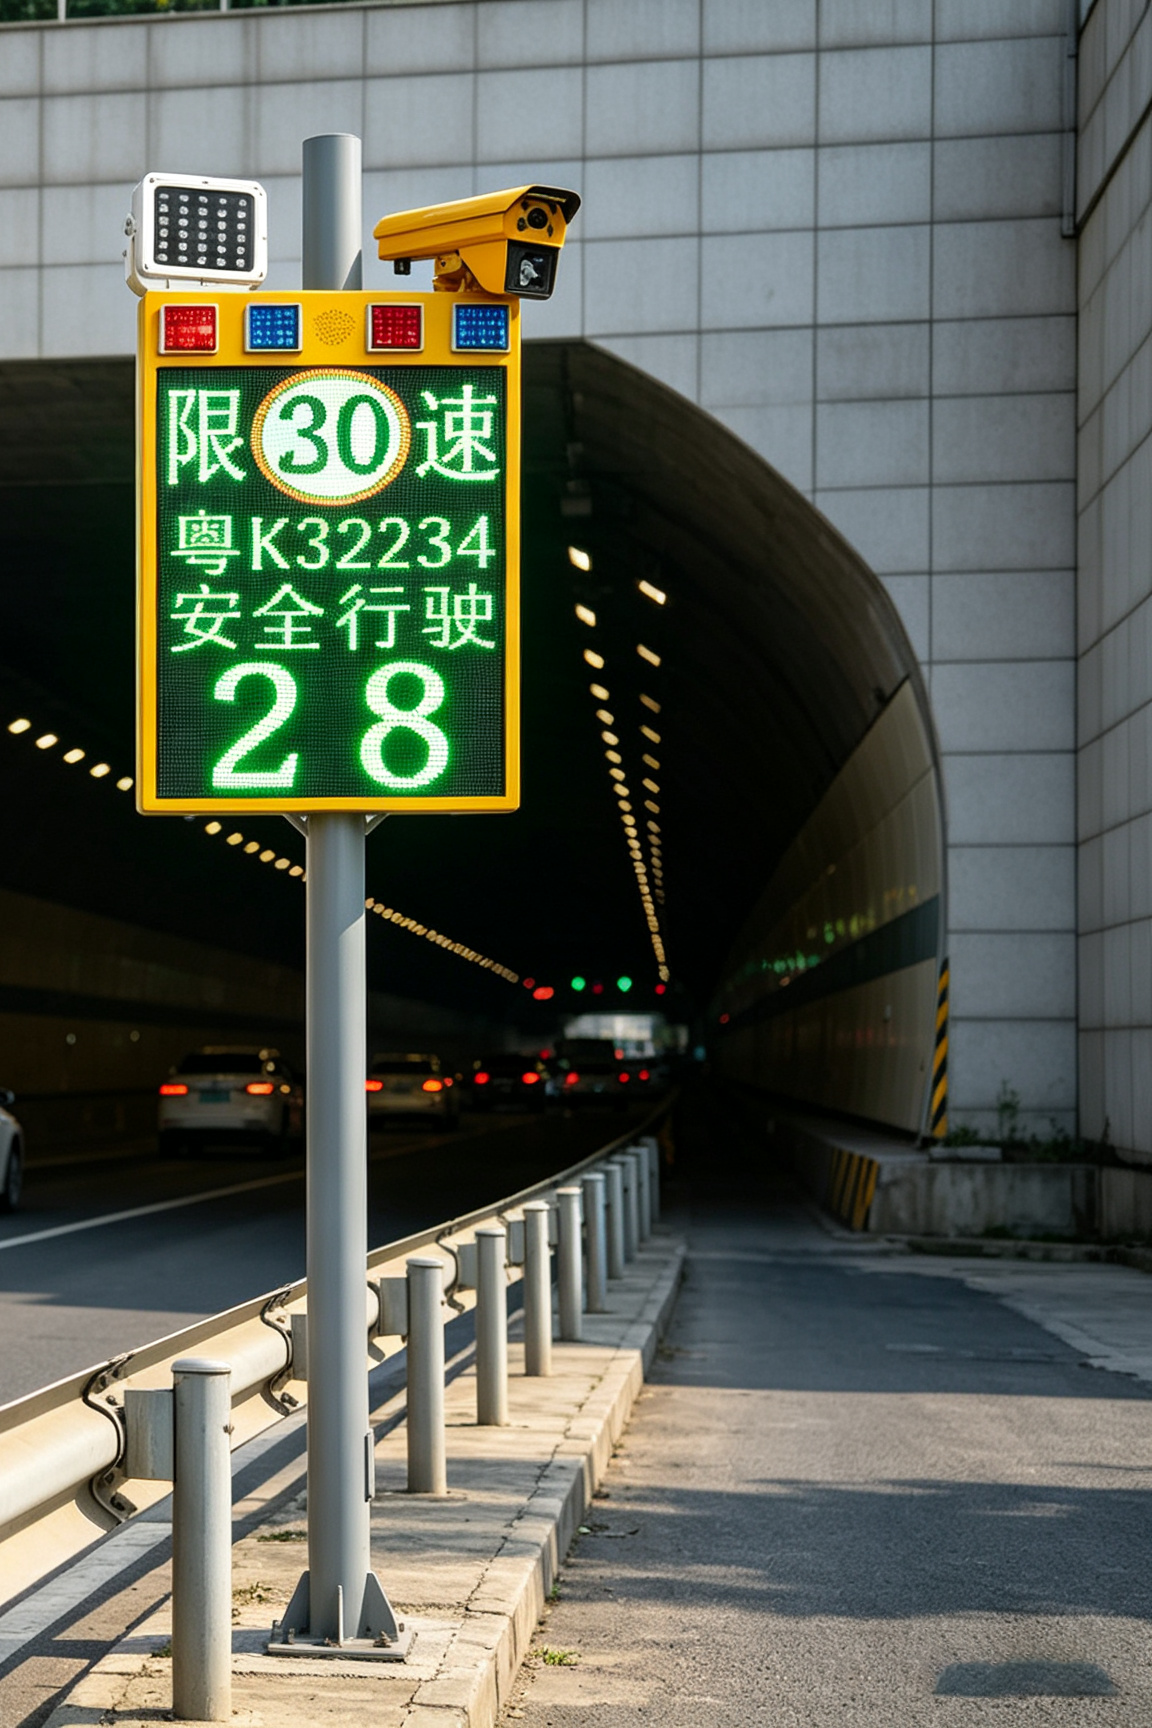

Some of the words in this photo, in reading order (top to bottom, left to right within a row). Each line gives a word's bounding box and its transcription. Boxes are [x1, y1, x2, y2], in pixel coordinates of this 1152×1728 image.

[168, 389, 246, 485] 限
[279, 395, 390, 475] 30
[416, 385, 499, 481] 速
[170, 510, 496, 576] 粤K32234
[170, 583, 496, 652] 安全行驶
